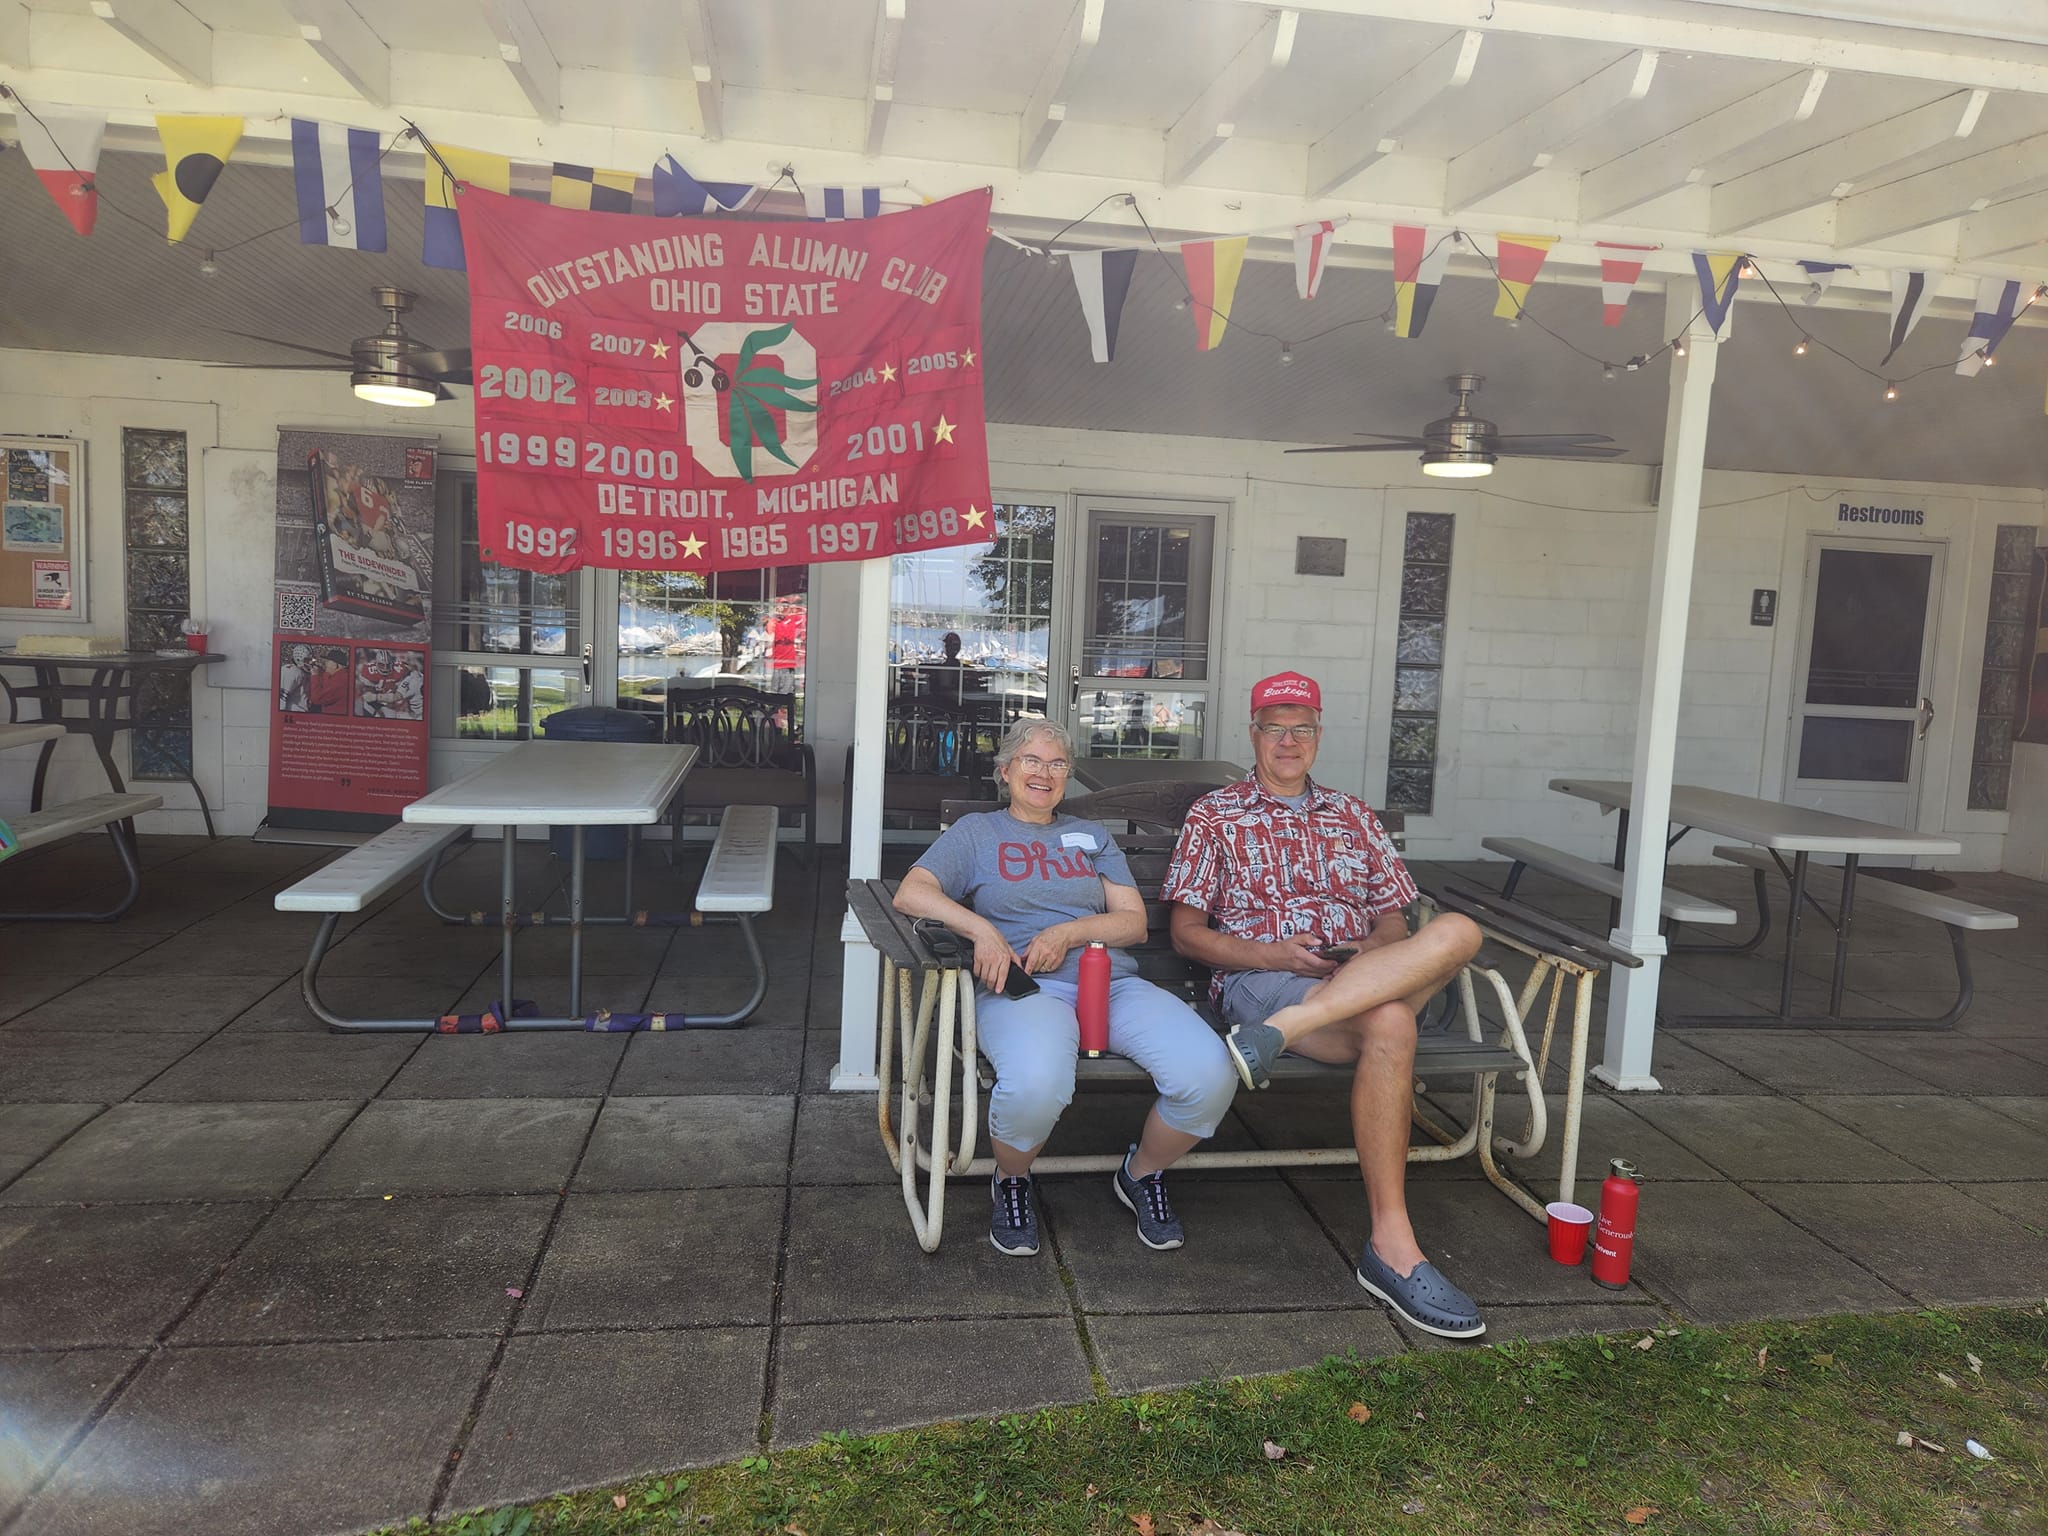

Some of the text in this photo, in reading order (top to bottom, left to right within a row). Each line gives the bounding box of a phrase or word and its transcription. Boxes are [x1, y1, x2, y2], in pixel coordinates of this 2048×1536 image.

[526, 232, 949, 309] OUTSTANDING ALUMNI CLUB
[650, 277, 839, 317] OHIO STATE
[504, 311, 563, 340] 2006
[590, 332, 646, 356] 2007
[907, 350, 959, 376] 2005
[479, 363, 577, 405] 2002
[829, 366, 878, 397] 2004
[594, 385, 653, 410] 2003
[480, 430, 680, 481] 1999 2000
[847, 420, 924, 461] 2001
[597, 472, 899, 519] DETROIT, MICHIGAN
[1839, 503, 1924, 526] Restrooms
[505, 506, 960, 560] 1992 1996 1985 1997 1998
[338, 548, 356, 562] THE
[358, 555, 408, 578] SIDEWINDER
[1263, 685, 1311, 699] Buckeyes
